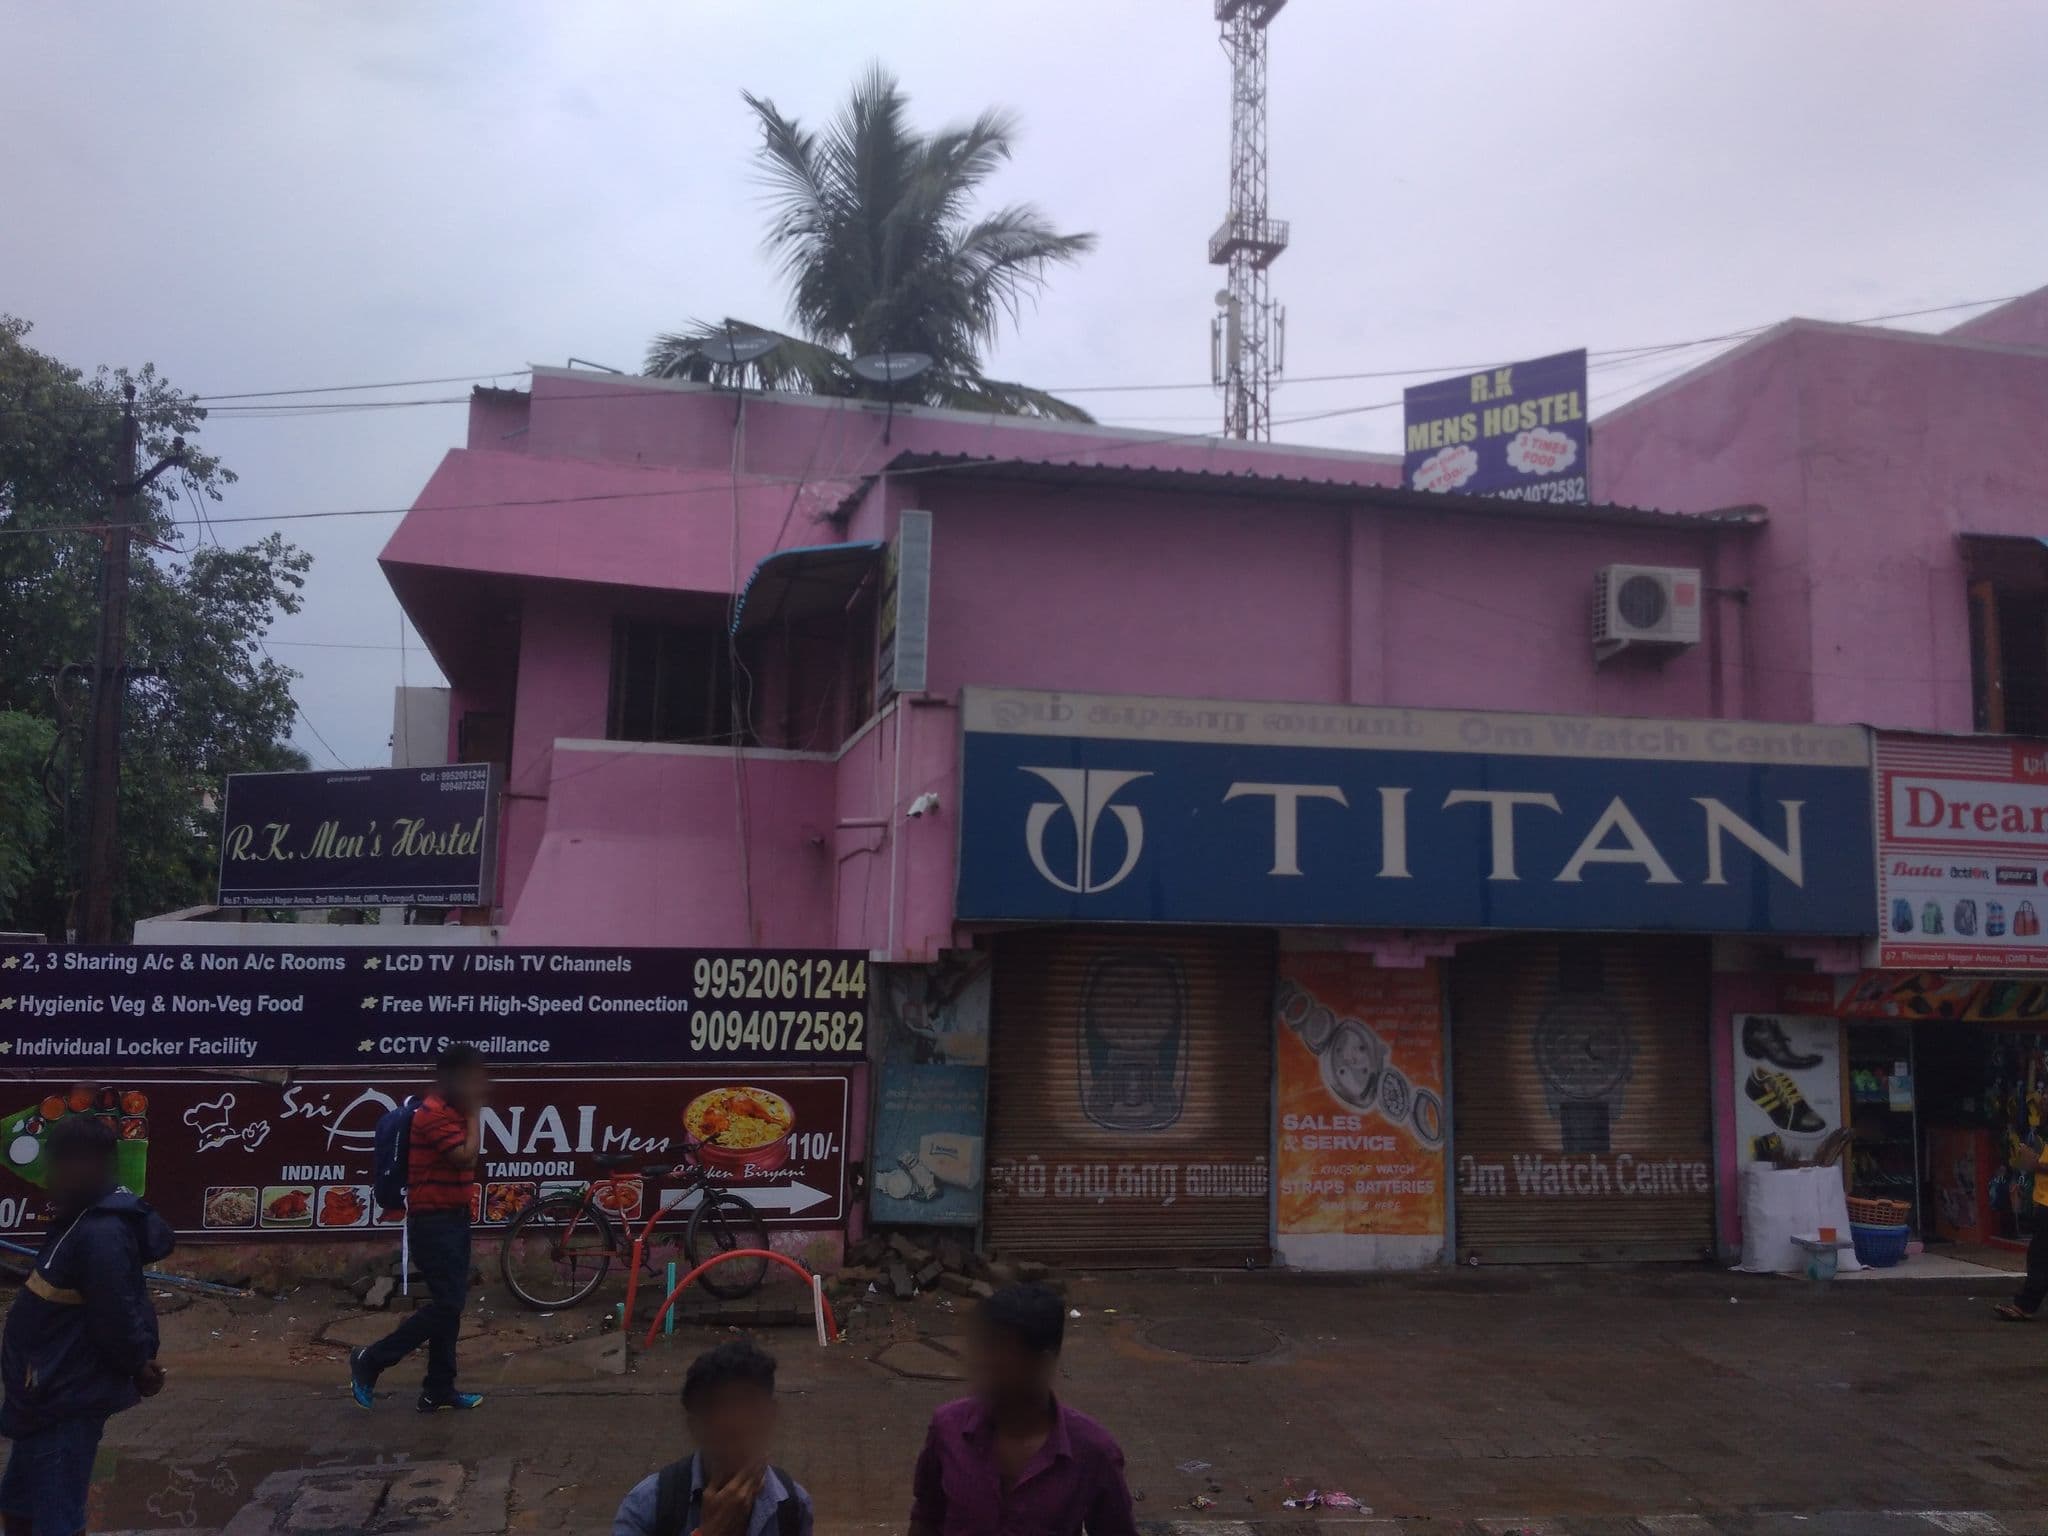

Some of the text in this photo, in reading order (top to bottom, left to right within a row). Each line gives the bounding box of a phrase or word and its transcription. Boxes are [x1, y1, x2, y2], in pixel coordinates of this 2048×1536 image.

[1471, 367, 1513, 403] R.K
[1407, 391, 1583, 452] MENS HOSTEL
[1523, 451, 1556, 467] FOOD
[1459, 716, 1850, 758] Om Watch Centre
[226, 817, 484, 861] R.K. Men's Hostel
[1221, 781, 1807, 889] TITAN
[47, 954, 58, 969] 3
[64, 953, 138, 975] Sharing
[143, 953, 174, 970] A/c
[180, 954, 194, 970] &
[201, 954, 238, 970] Non
[243, 954, 275, 970] A/c
[281, 954, 346, 971] Rooms
[385, 954, 422, 971] LCD
[427, 955, 454, 972] TV
[475, 955, 514, 972] Dish
[520, 956, 545, 972] TV
[550, 956, 632, 972] Channels
[693, 958, 867, 1000] 9952061244
[19, 995, 304, 1015] Hygienic Veg & Non-Veg Food
[382, 996, 689, 1015] Free Wi-Fi High-Speed Connection
[690, 1010, 864, 1051] 9094072582
[15, 1037, 258, 1058] Individual Locker Facility
[379, 1037, 432, 1054] CCTV
[280, 1085, 670, 1155] Sri ANAI Mess
[1282, 1113, 1362, 1131] SALES
[787, 1132, 840, 1161] 110/-
[1302, 1136, 1396, 1152] SERVICE
[281, 1160, 575, 1181] INDIAN TANDOORI
[744, 1163, 806, 1182] Biryani
[1376, 1164, 1416, 1175] WATCH
[1458, 1153, 1709, 1196] Om Watch Centre
[1280, 1179, 1435, 1195] STRAPS BATTERIES
